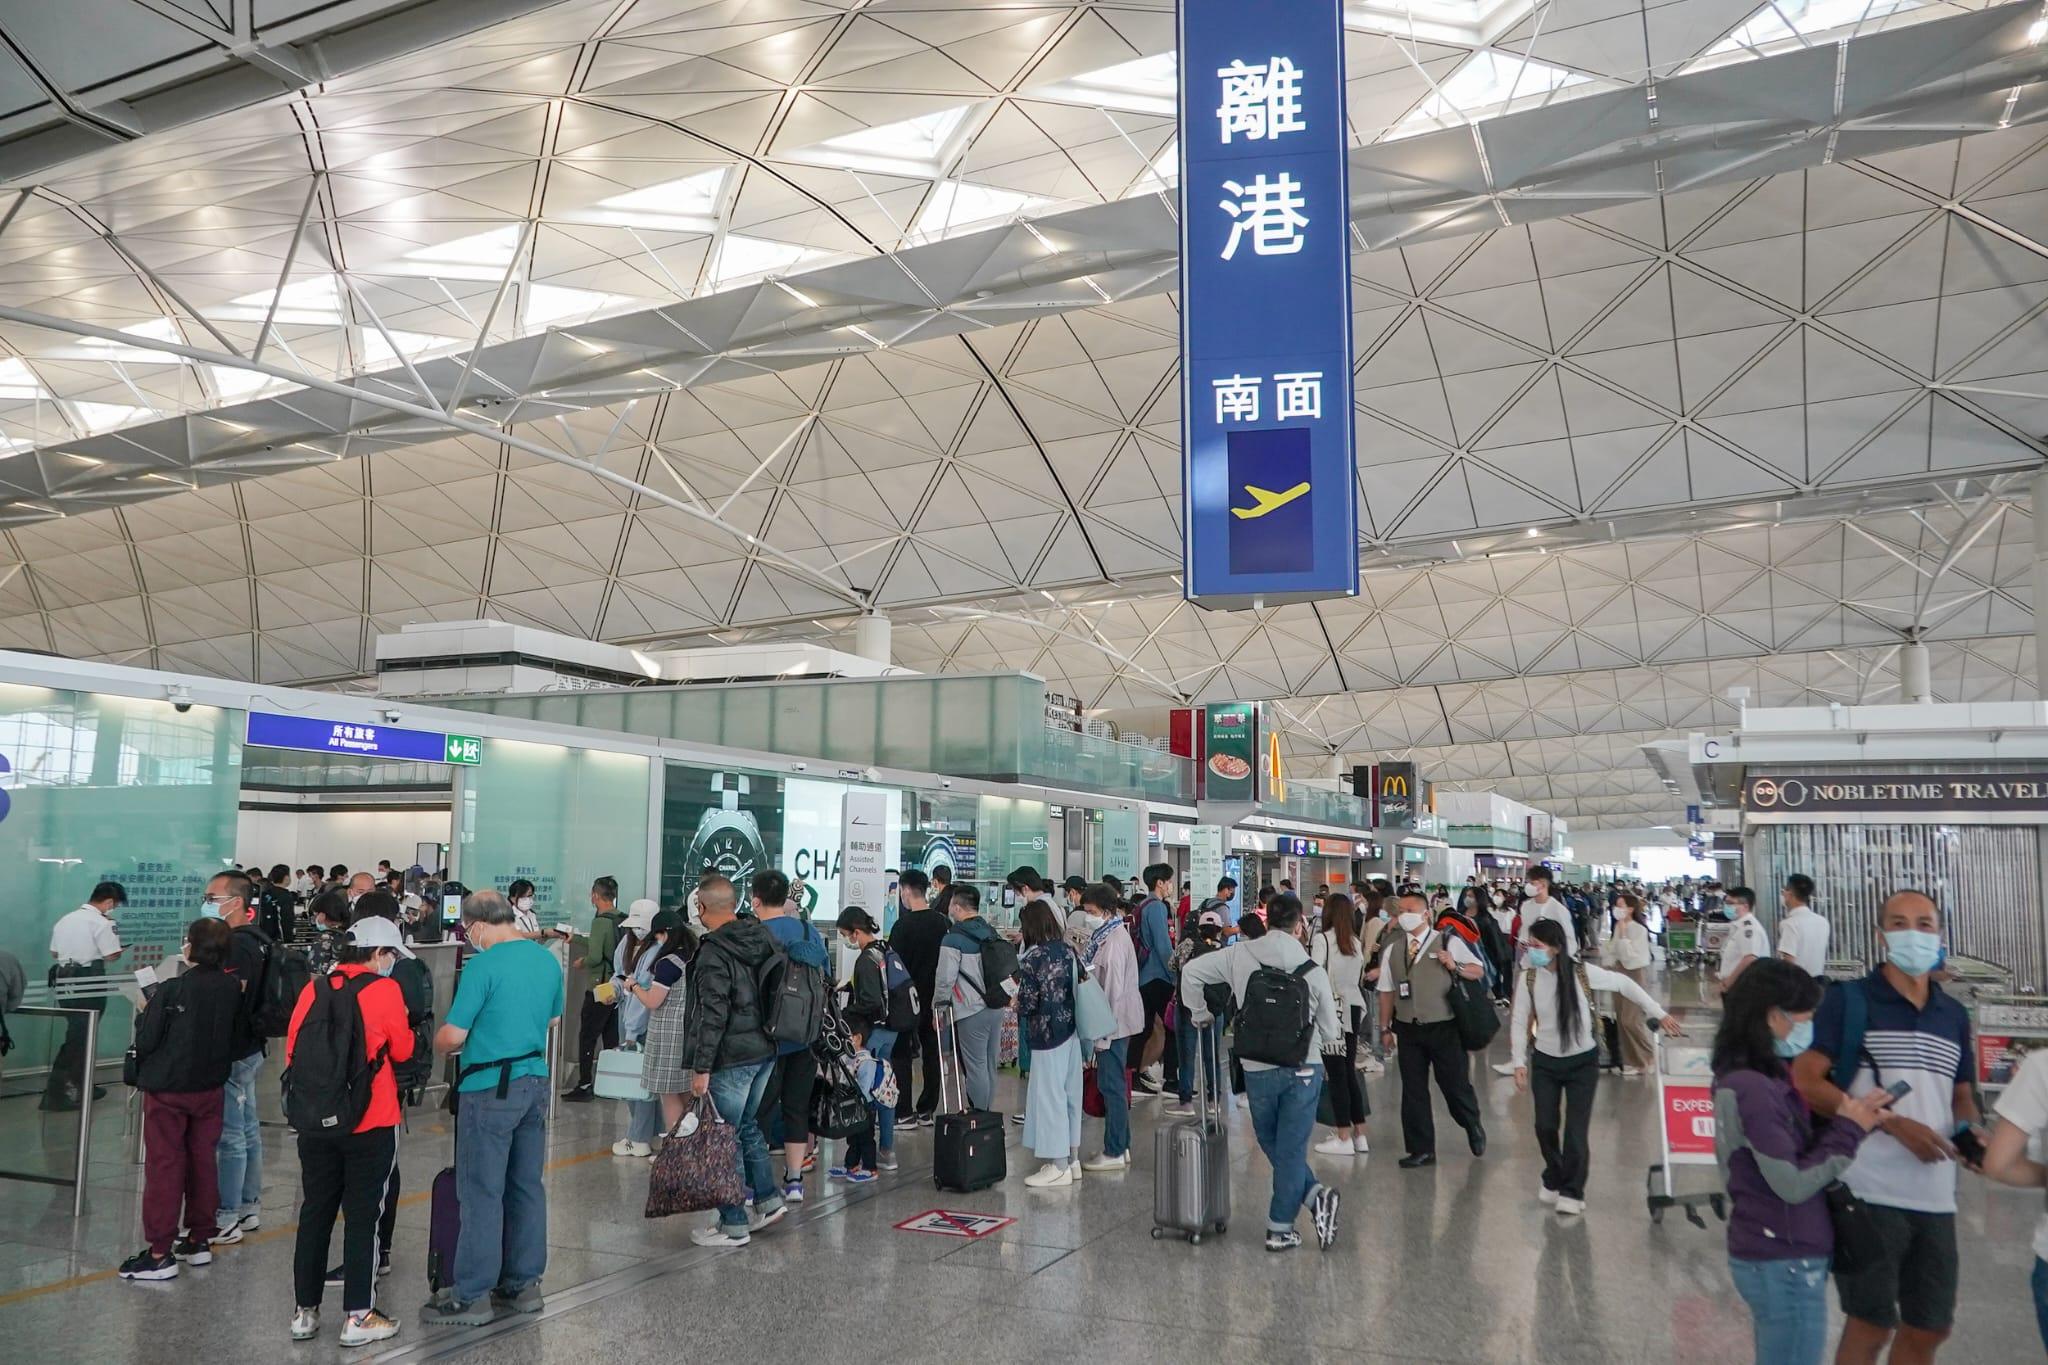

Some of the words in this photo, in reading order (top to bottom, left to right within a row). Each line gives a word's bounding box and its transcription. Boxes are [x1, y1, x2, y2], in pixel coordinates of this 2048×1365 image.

[1217, 56, 1310, 262] 離港
[1212, 370, 1324, 424] 南面
[333, 724, 376, 741] 所有旅客
[340, 738, 379, 751] Passengers
[1704, 740, 1720, 759] C
[1813, 784, 1944, 800] NOBLETIME
[850, 841, 882, 853] 輔助通道
[850, 855, 875, 863] Assisted
[849, 865, 877, 874] Channels
